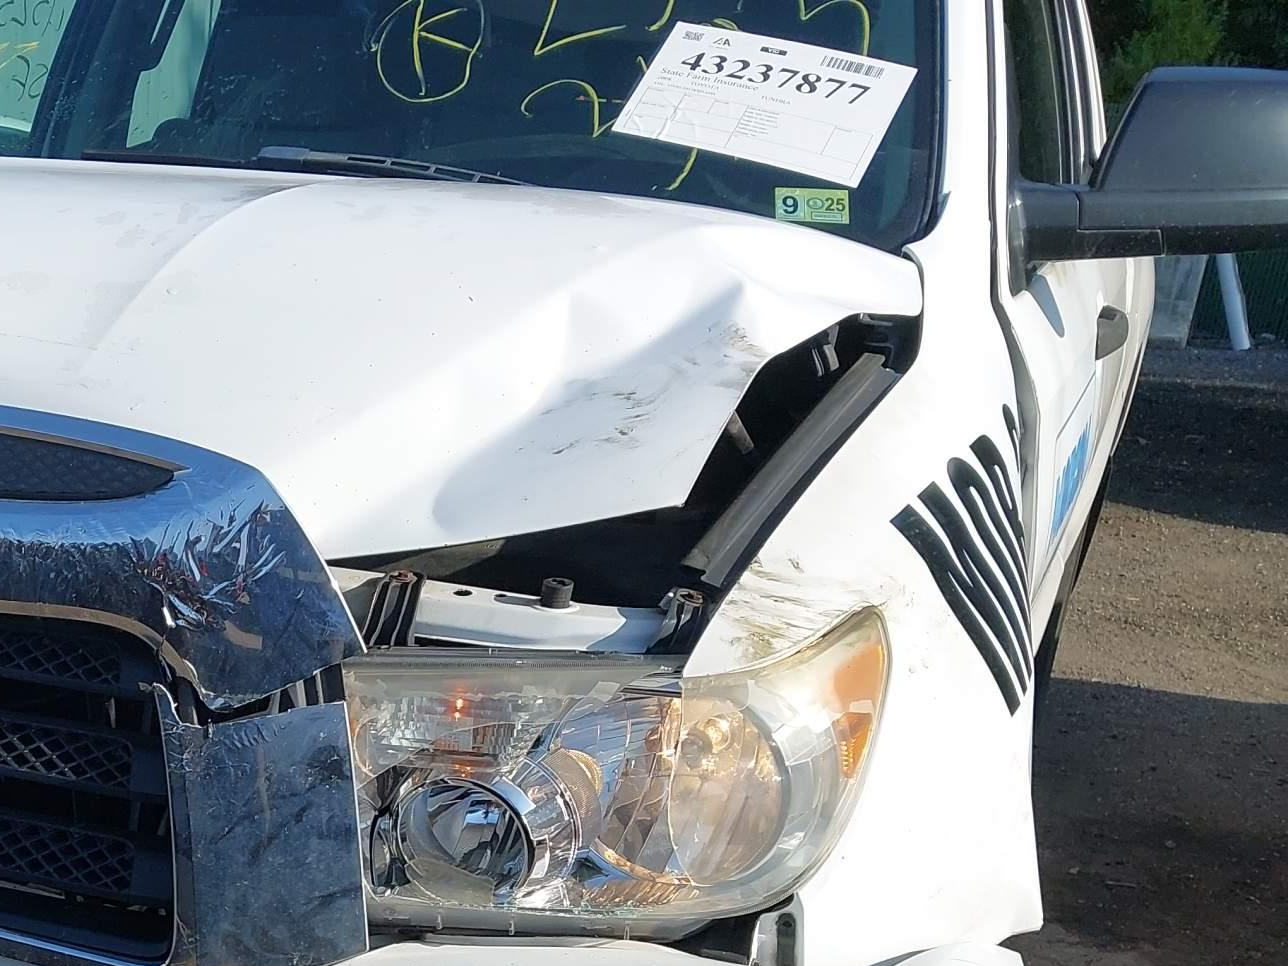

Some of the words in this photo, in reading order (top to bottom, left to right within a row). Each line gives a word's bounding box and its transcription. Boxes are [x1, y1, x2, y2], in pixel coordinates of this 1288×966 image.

[660, 66, 684, 78] State
[686, 71, 712, 83] Farm
[714, 76, 760, 92] Insurance
[681, 51, 872, 105] 43237877
[782, 195, 799, 215] 9
[825, 197, 846, 212] 25
